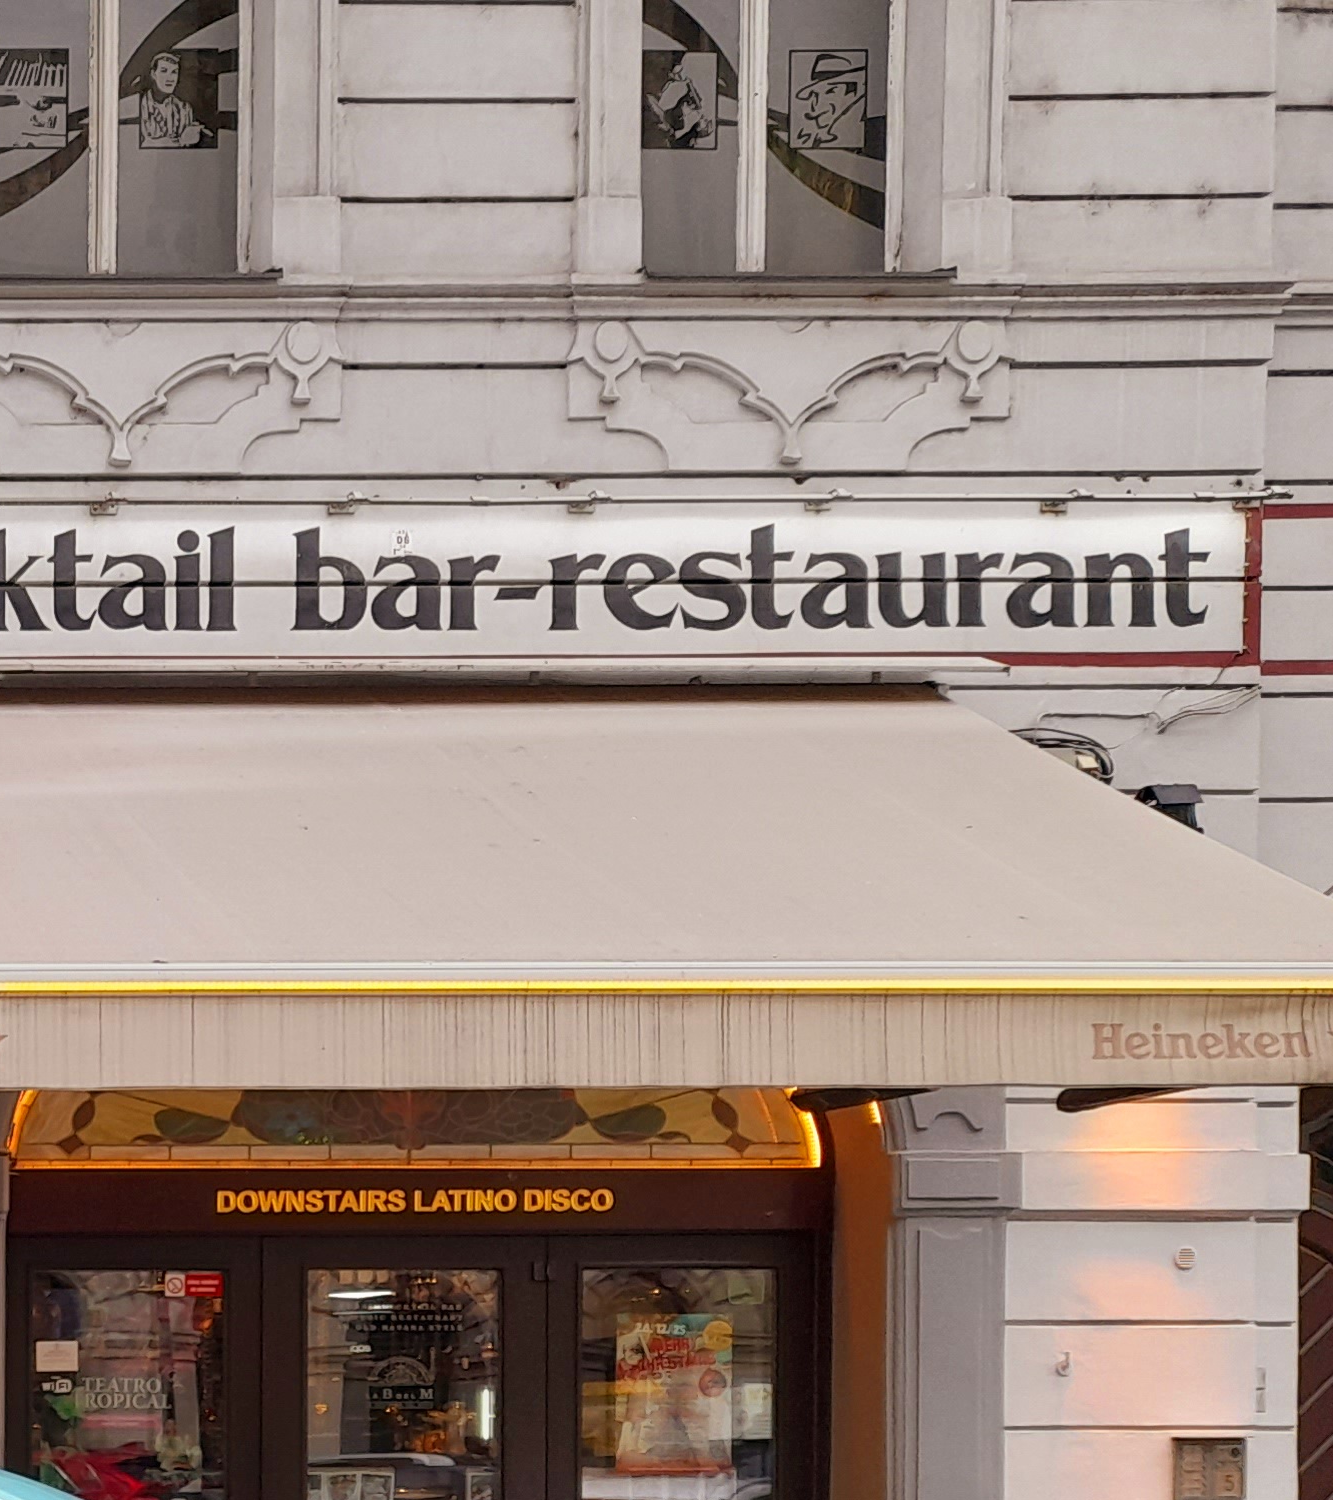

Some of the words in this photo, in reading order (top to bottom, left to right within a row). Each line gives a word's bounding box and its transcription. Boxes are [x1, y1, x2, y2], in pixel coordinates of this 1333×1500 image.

[1091, 1022, 1313, 1060] Heineken
[216, 1189, 406, 1214] DOWNSTAIRS
[414, 1189, 516, 1214] LATINO
[524, 1189, 615, 1214] DISCO
[82, 1376, 162, 1394] TEATRO
